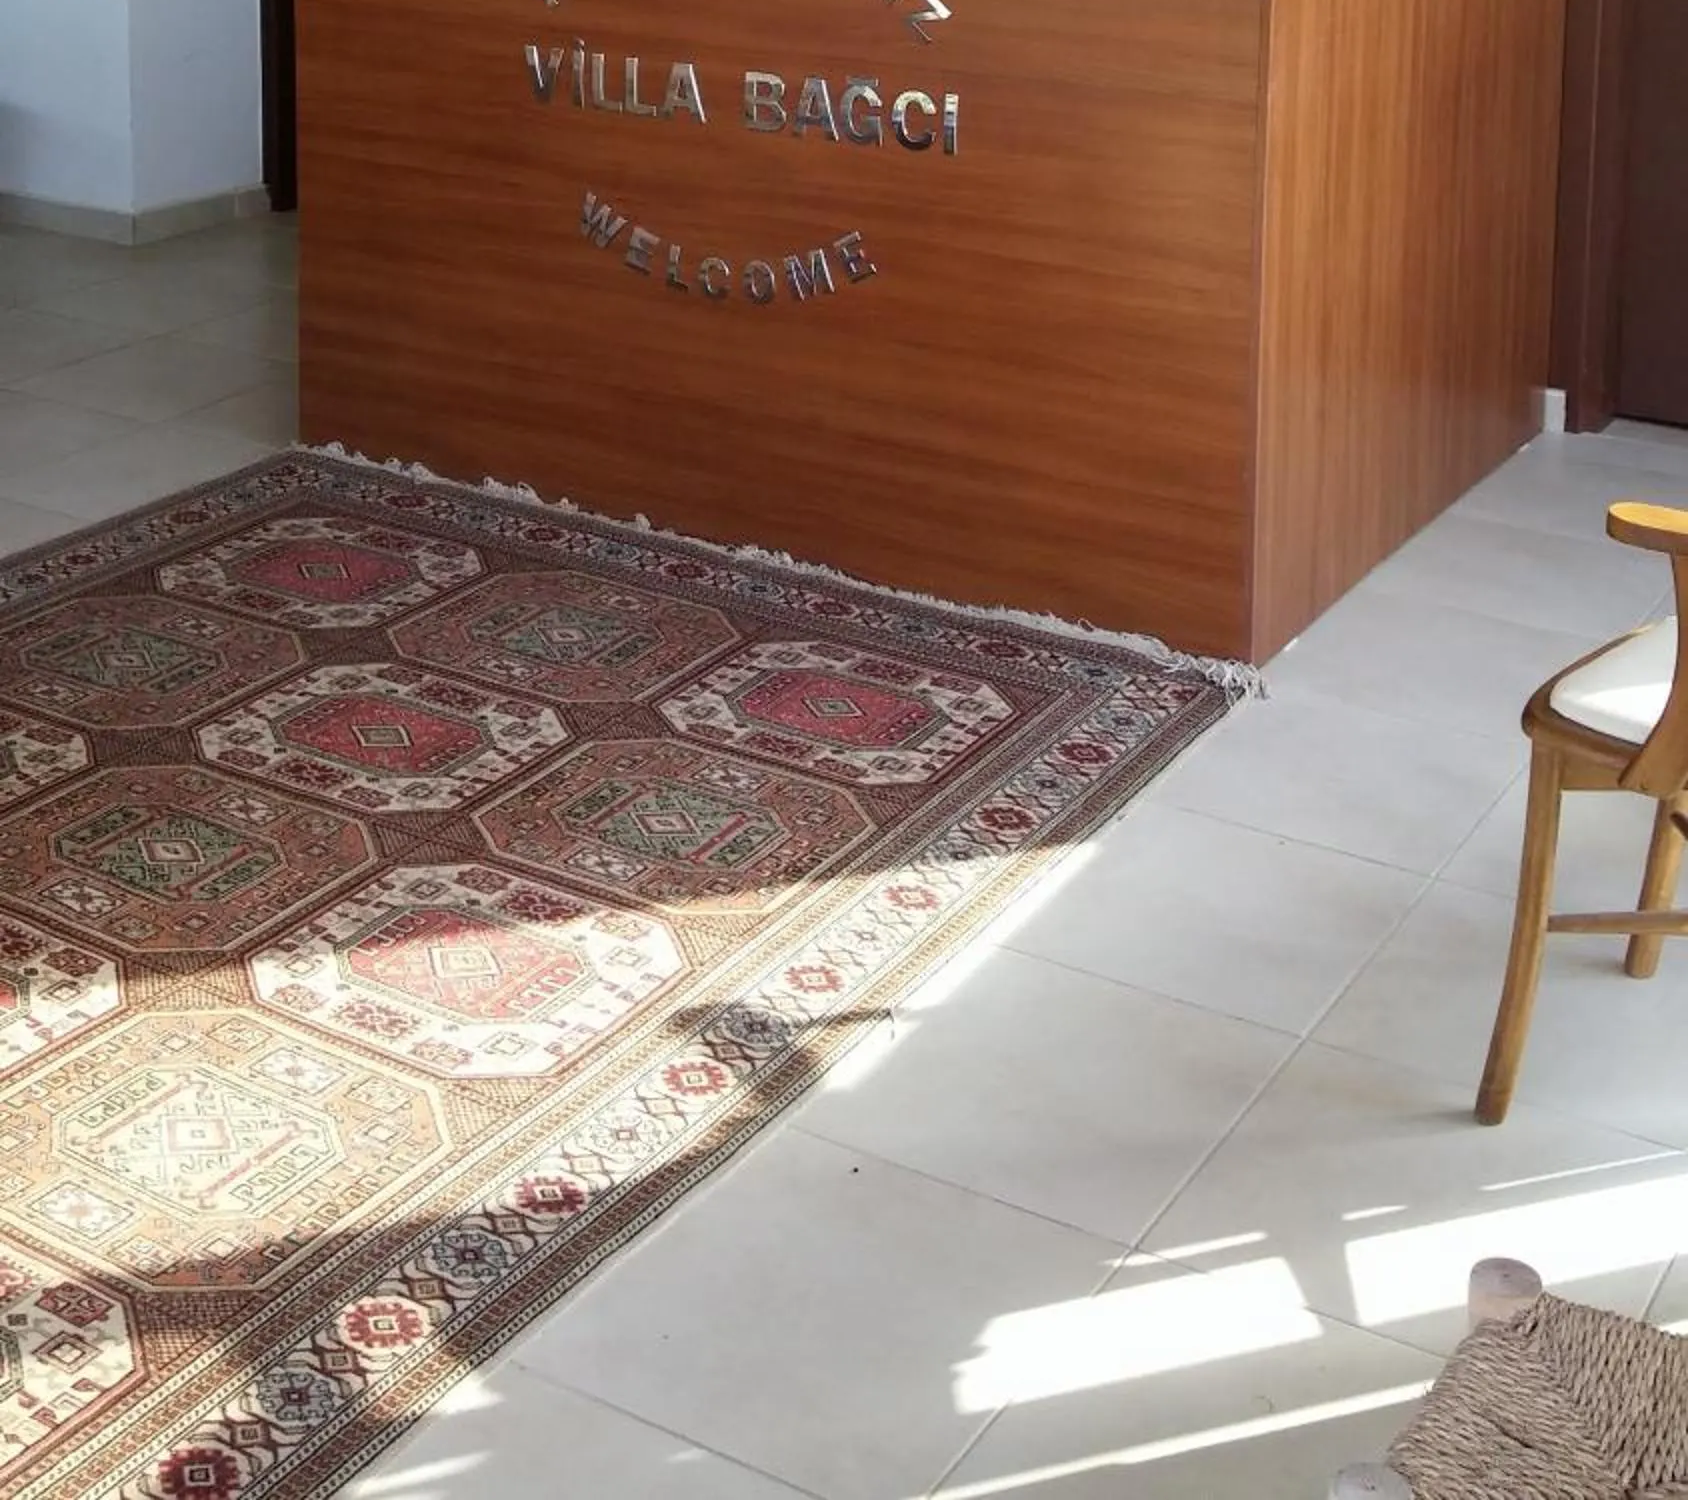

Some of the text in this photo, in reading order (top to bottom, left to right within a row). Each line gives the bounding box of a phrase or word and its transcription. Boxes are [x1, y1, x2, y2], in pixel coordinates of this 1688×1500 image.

[524, 38, 959, 156] VİLLA BAĞCI
[580, 191, 877, 302] WELCOME
